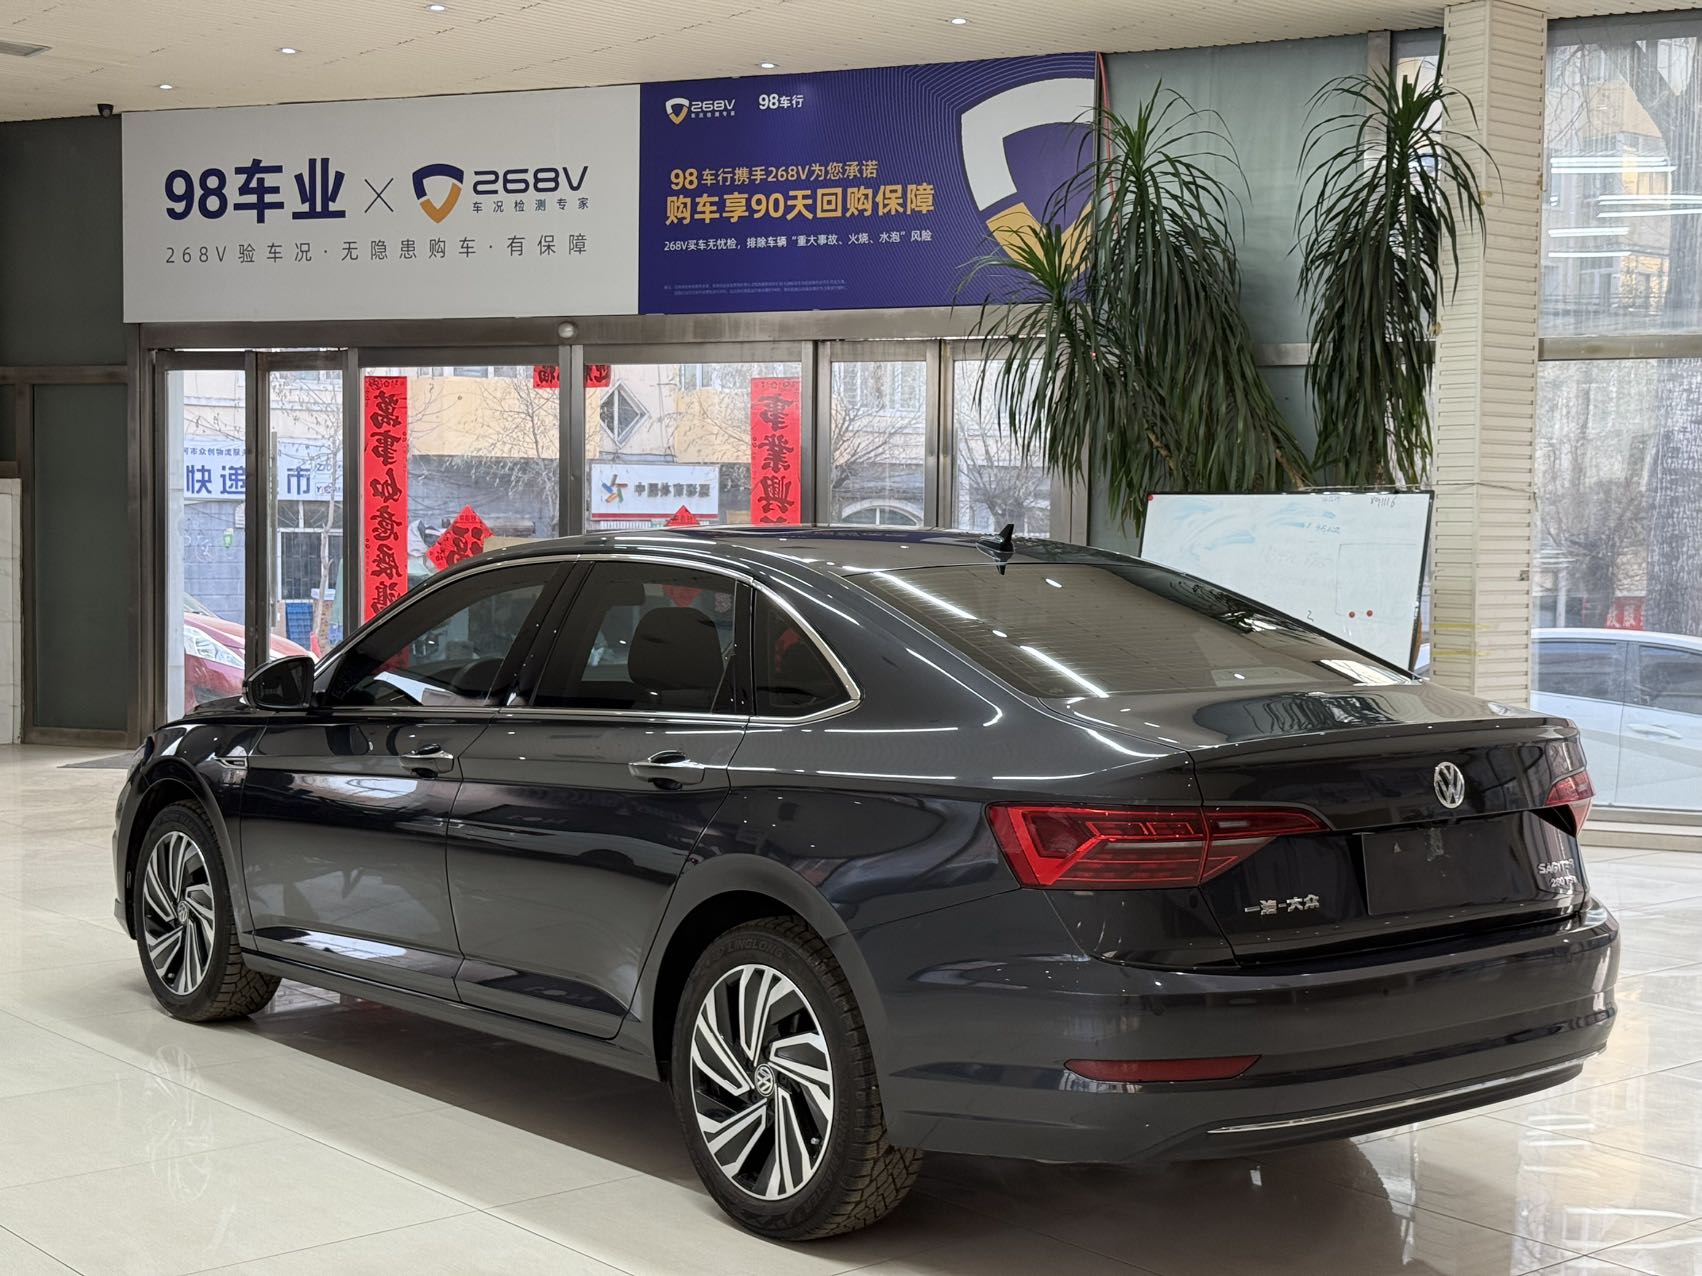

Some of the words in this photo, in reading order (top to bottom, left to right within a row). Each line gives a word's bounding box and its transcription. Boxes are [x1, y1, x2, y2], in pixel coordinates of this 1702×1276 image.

[691, 99, 736, 113] 268V
[758, 93, 804, 110] 98车行
[670, 159, 879, 190] 98车行携手268V为您承诺
[164, 157, 347, 225] 98车业
[472, 165, 589, 196] 268V
[665, 181, 935, 225] 购车享90天回购保障
[472, 197, 589, 214] 车况检测专家
